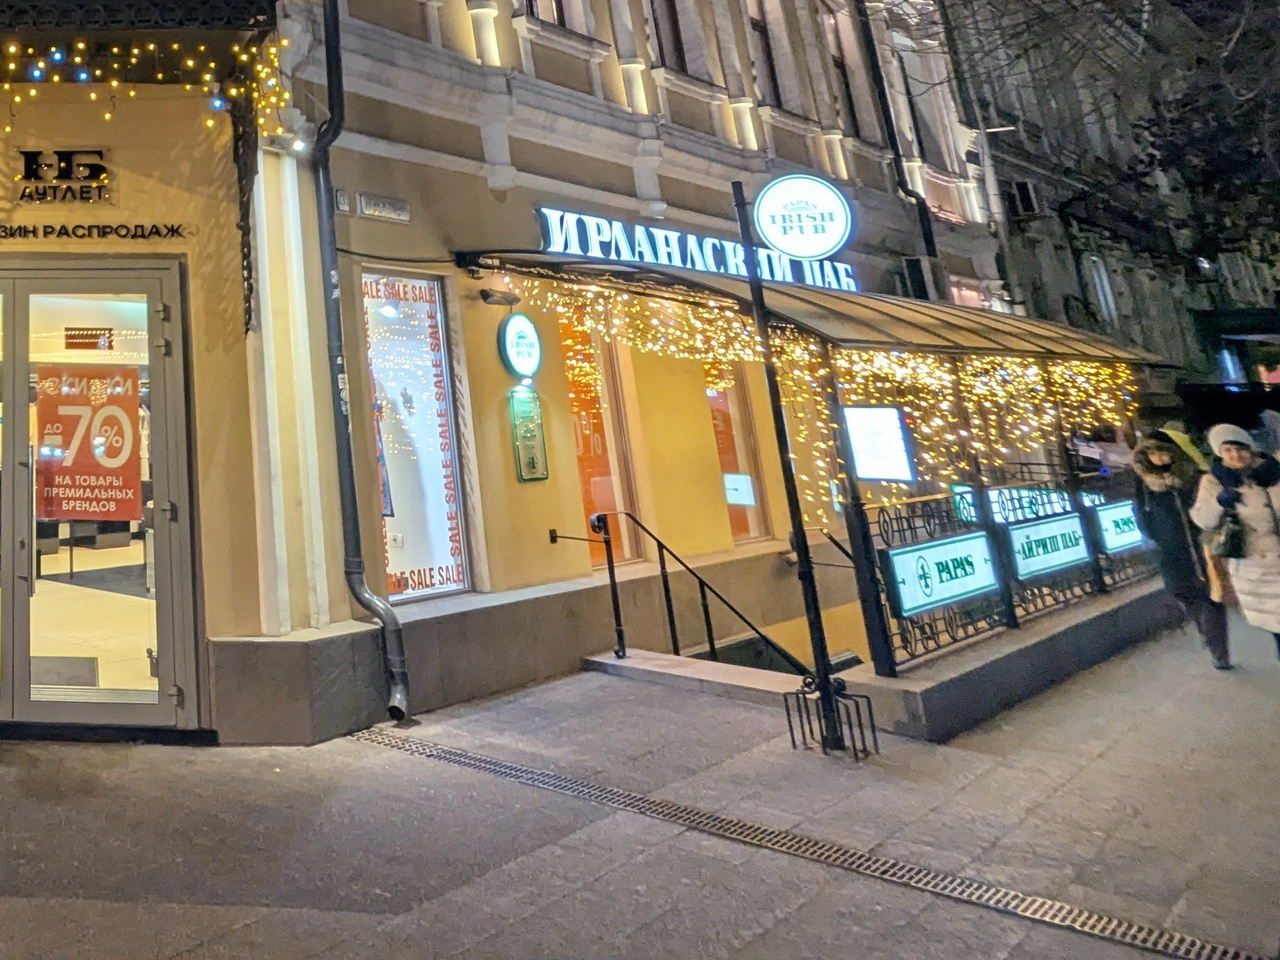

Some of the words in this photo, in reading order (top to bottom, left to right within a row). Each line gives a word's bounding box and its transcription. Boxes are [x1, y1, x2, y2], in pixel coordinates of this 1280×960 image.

[20, 185, 107, 201] АУТЛЕТ
[769, 212, 835, 225] IRISH
[43, 224, 184, 240] РАСПРОДАЖ
[781, 224, 826, 236] PUB
[412, 285, 435, 303] SALE
[427, 310, 440, 353] SALE
[432, 358, 445, 402] SALE
[43, 423, 62, 434] ДО
[436, 408, 450, 453] SALE
[55, 475, 71, 485] НА
[75, 475, 123, 486] ТОВАРЫ
[441, 459, 456, 504] SALE
[44, 487, 134, 499] ПРЕМИАЛЬНЫХ
[62, 500, 117, 512] БРЕНДОВ
[447, 511, 461, 558] SALE
[1021, 534, 1061, 560] АЙРИШ
[1060, 530, 1080, 550] ПАБ
[409, 567, 434, 591] SALE
[439, 564, 463, 585] SALE
